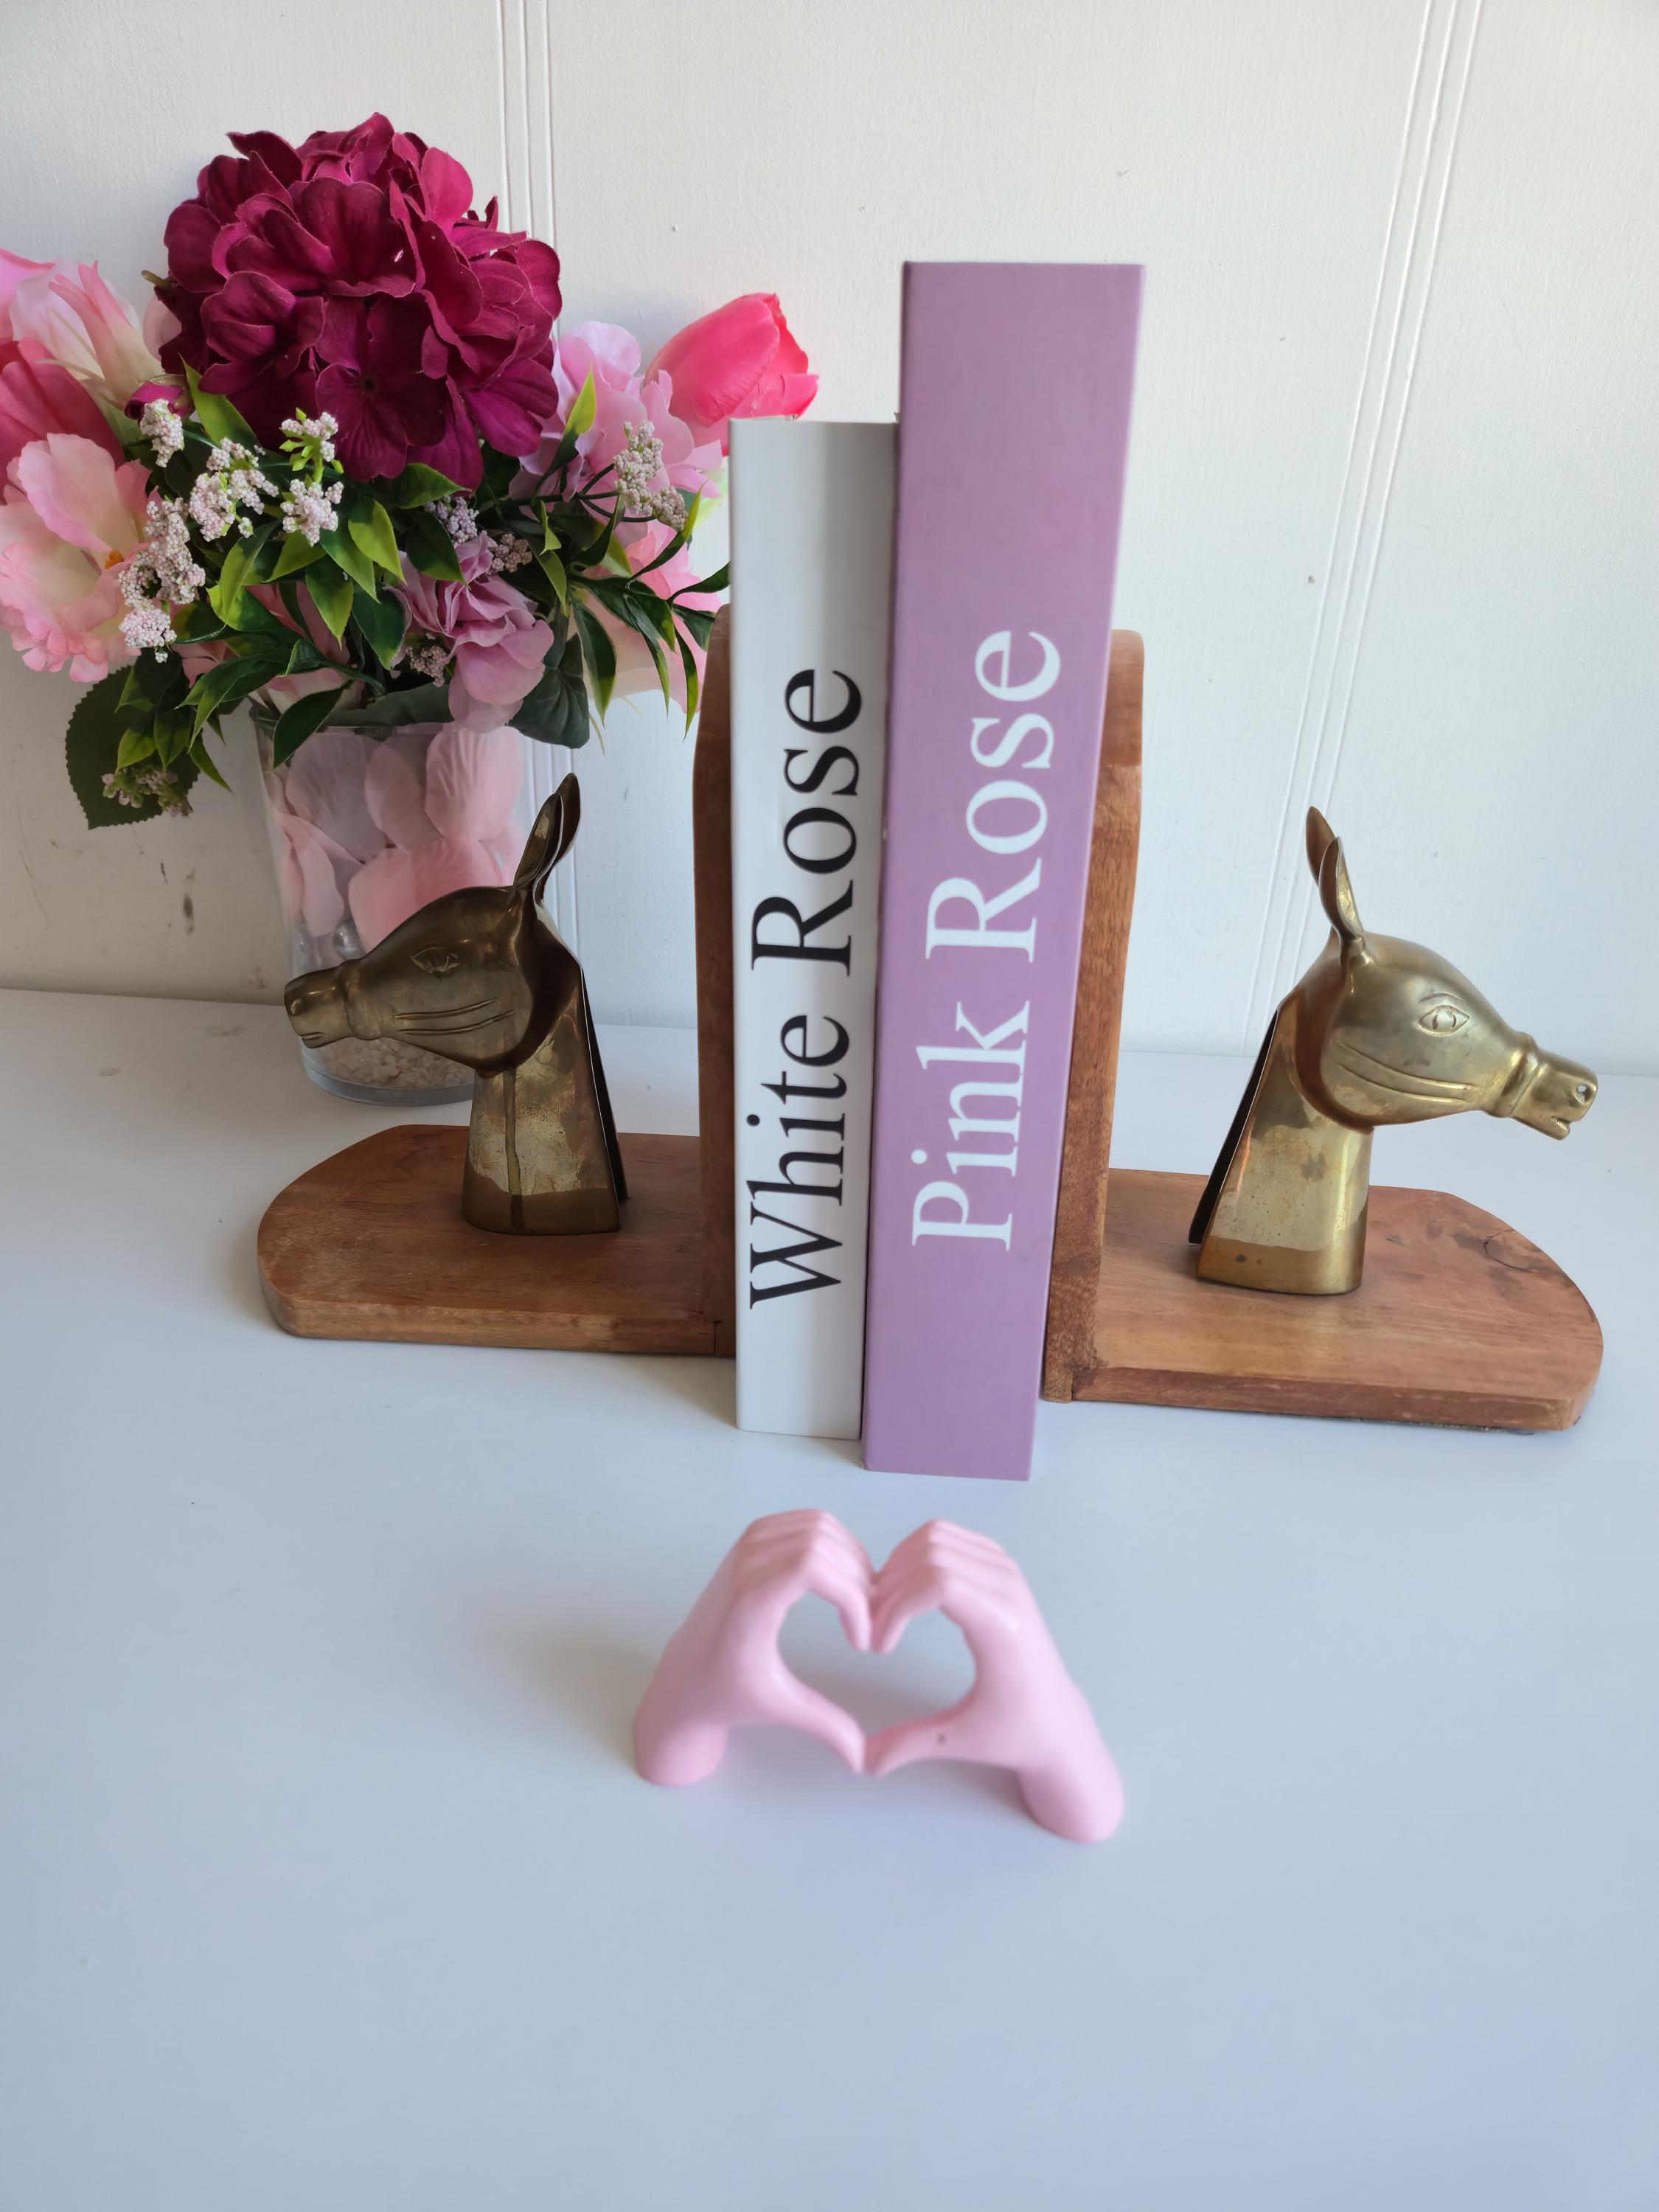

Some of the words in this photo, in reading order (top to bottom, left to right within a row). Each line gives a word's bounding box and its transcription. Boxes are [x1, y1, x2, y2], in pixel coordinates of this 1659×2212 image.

[751, 668, 863, 977] Rose
[923, 628, 1062, 964] Rose
[746, 1014, 850, 1310] White
[909, 998, 1032, 1252] Pink
